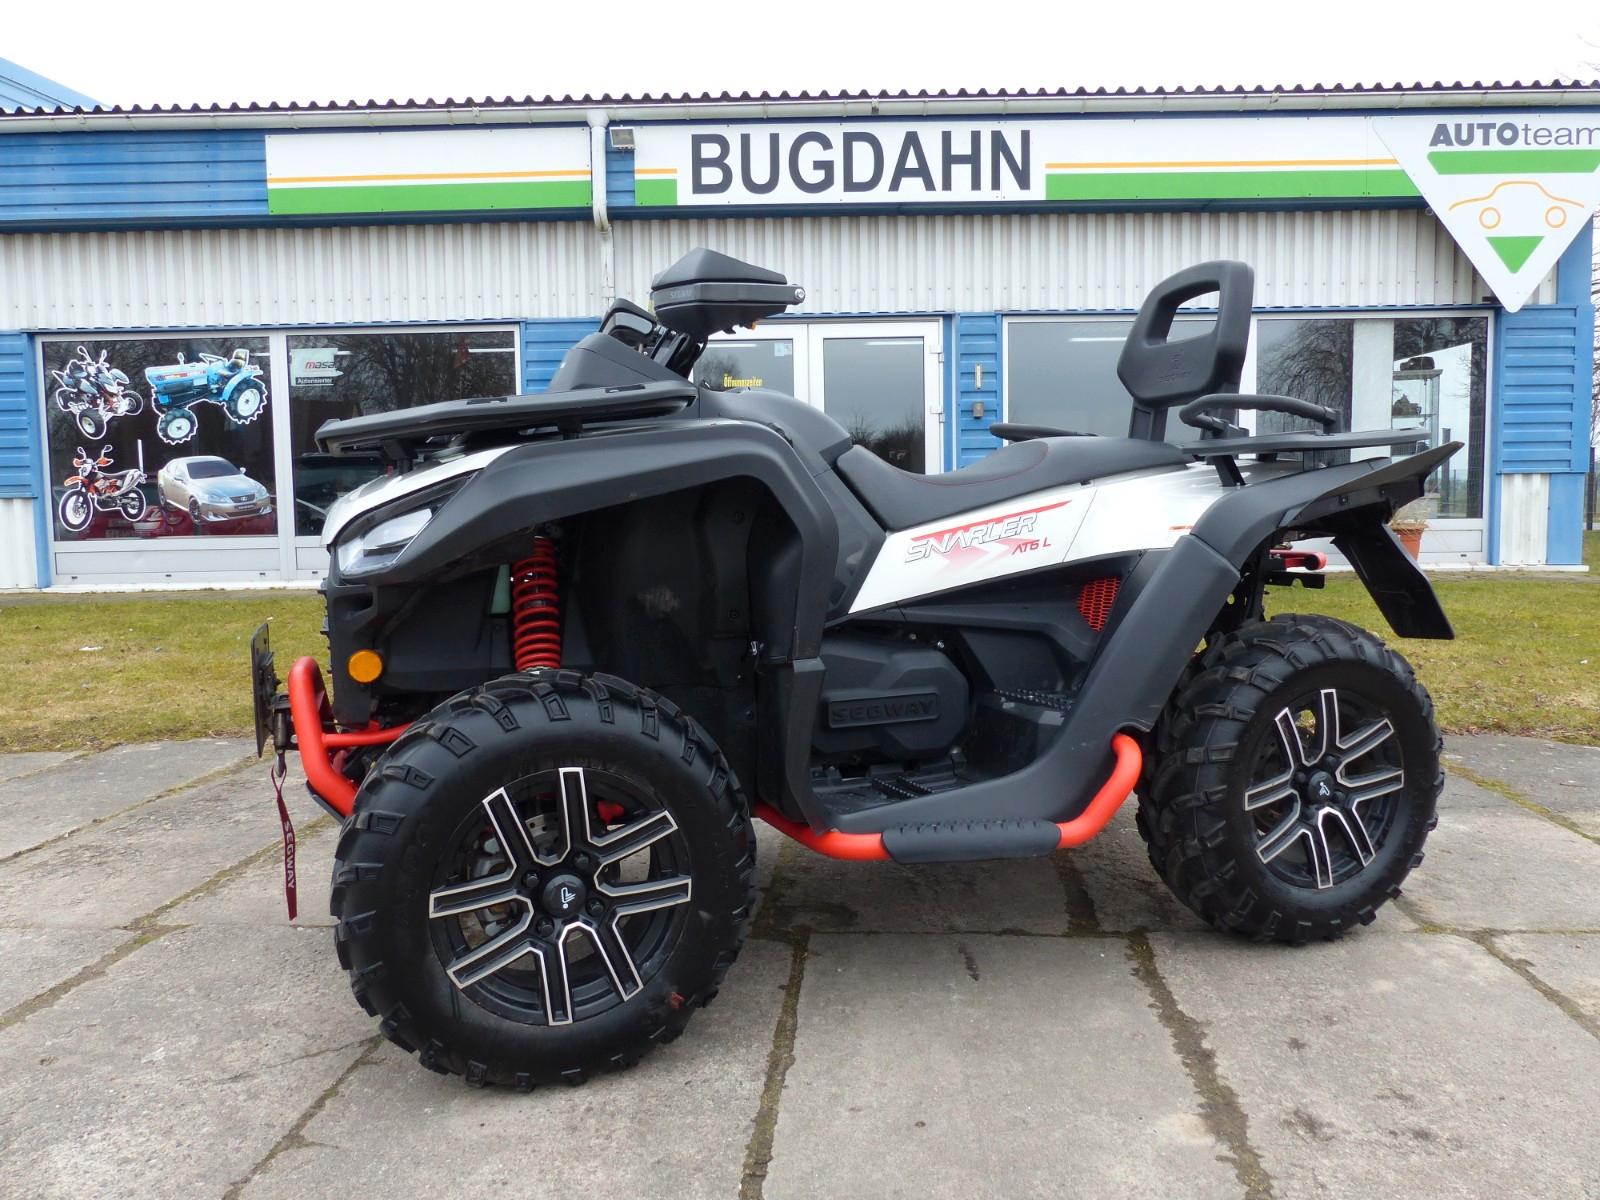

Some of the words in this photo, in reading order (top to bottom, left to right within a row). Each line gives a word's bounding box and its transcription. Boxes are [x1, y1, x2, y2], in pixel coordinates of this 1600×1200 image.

[691, 130, 1031, 194] BUGDAHN
[904, 512, 1038, 563] SNARLER
[1011, 540, 1040, 556] AT6
[1043, 537, 1052, 548] L
[831, 700, 935, 722] SEGWAY
[283, 821, 295, 888] SEGWAY
